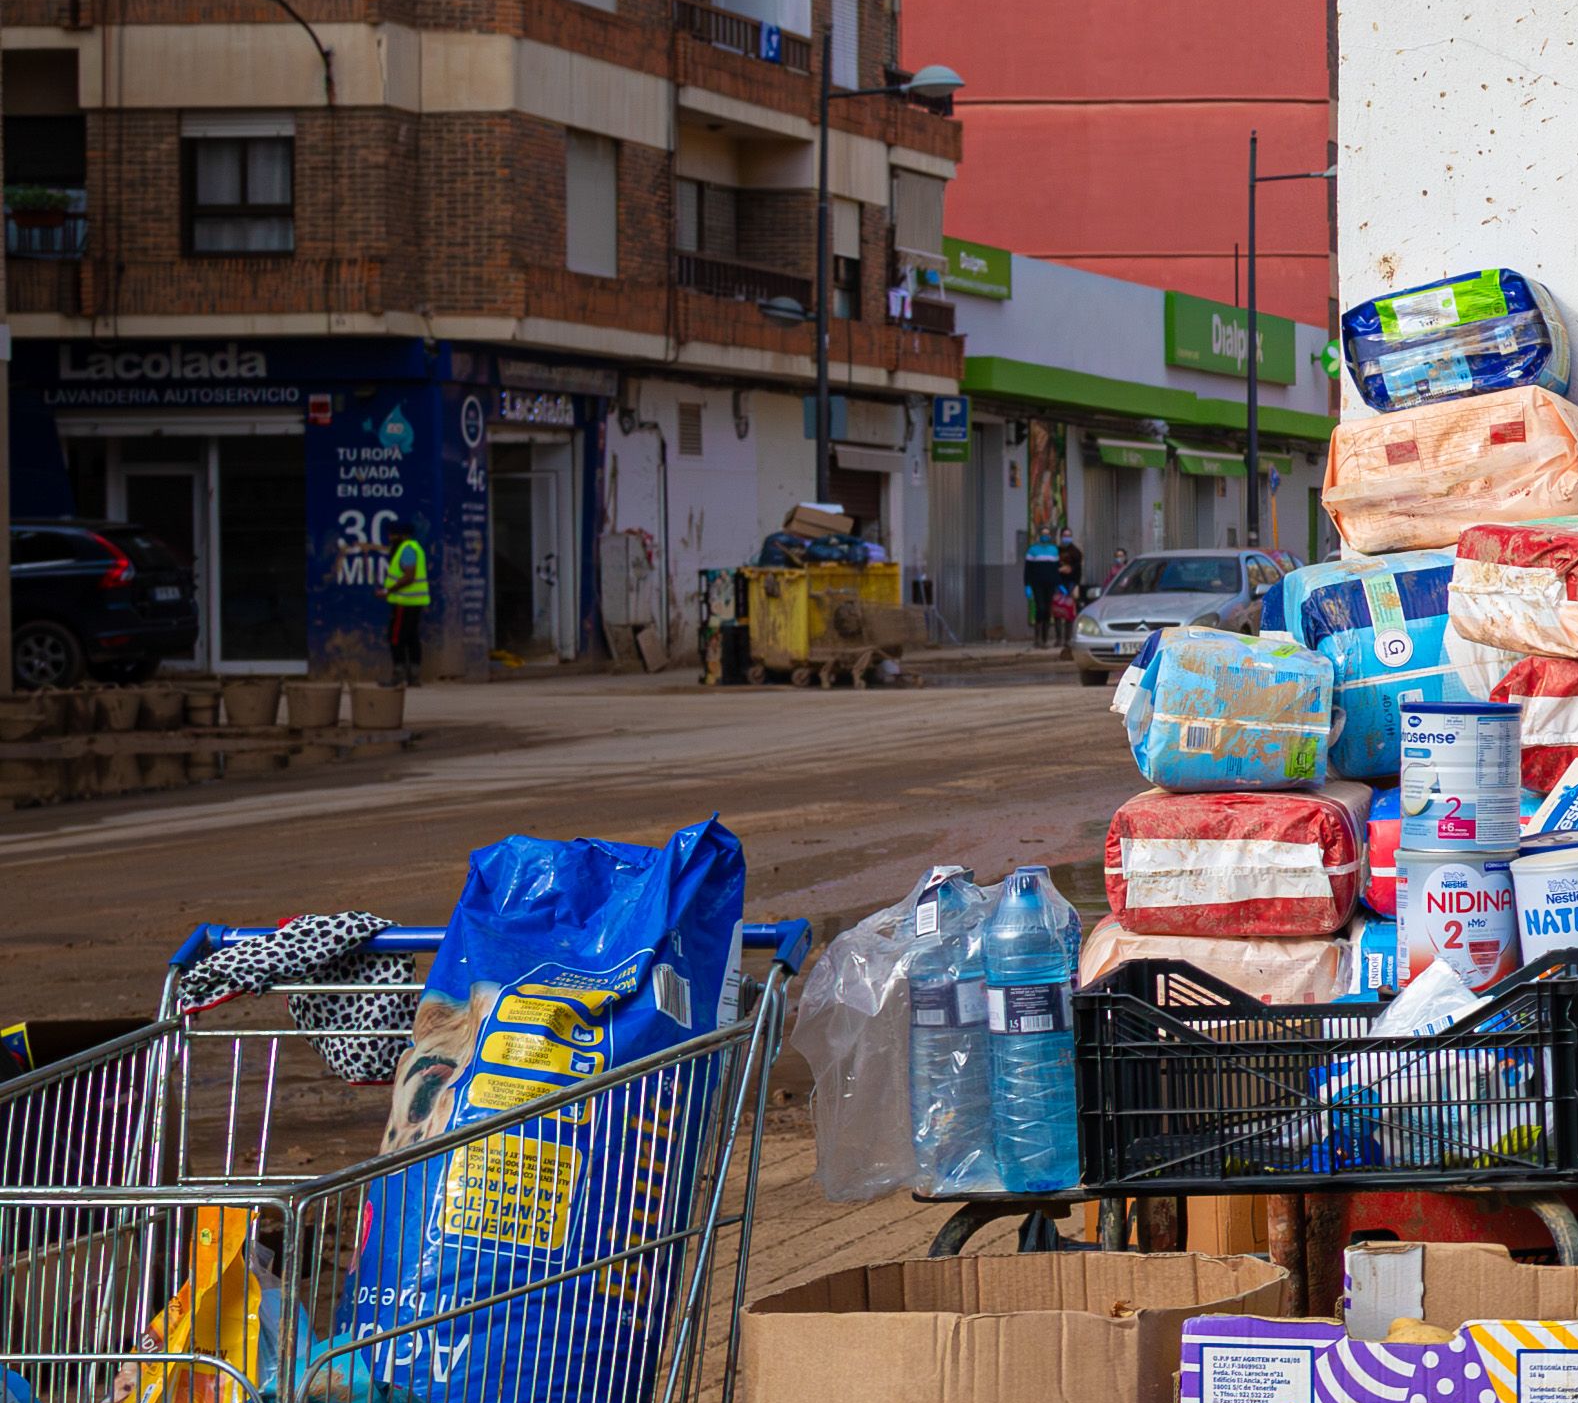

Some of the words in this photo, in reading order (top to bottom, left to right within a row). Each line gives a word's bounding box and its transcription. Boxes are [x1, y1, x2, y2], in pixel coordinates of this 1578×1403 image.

[59, 343, 267, 380] Lacolada
[164, 386, 300, 404] AUTOSERVICIO
[942, 400, 962, 422] P
[337, 448, 357, 461] TU
[360, 447, 403, 462] ROPA
[340, 465, 400, 480] LAVADA
[337, 484, 358, 498] EN
[361, 484, 404, 498] SOLO
[1444, 797, 1462, 821] 2
[1440, 823, 1455, 832] +6
[1441, 879, 1469, 889] Nestlé
[1427, 888, 1513, 913] NIDINA
[1443, 920, 1464, 949] 2
[1270, 1378, 1291, 1386] planta
